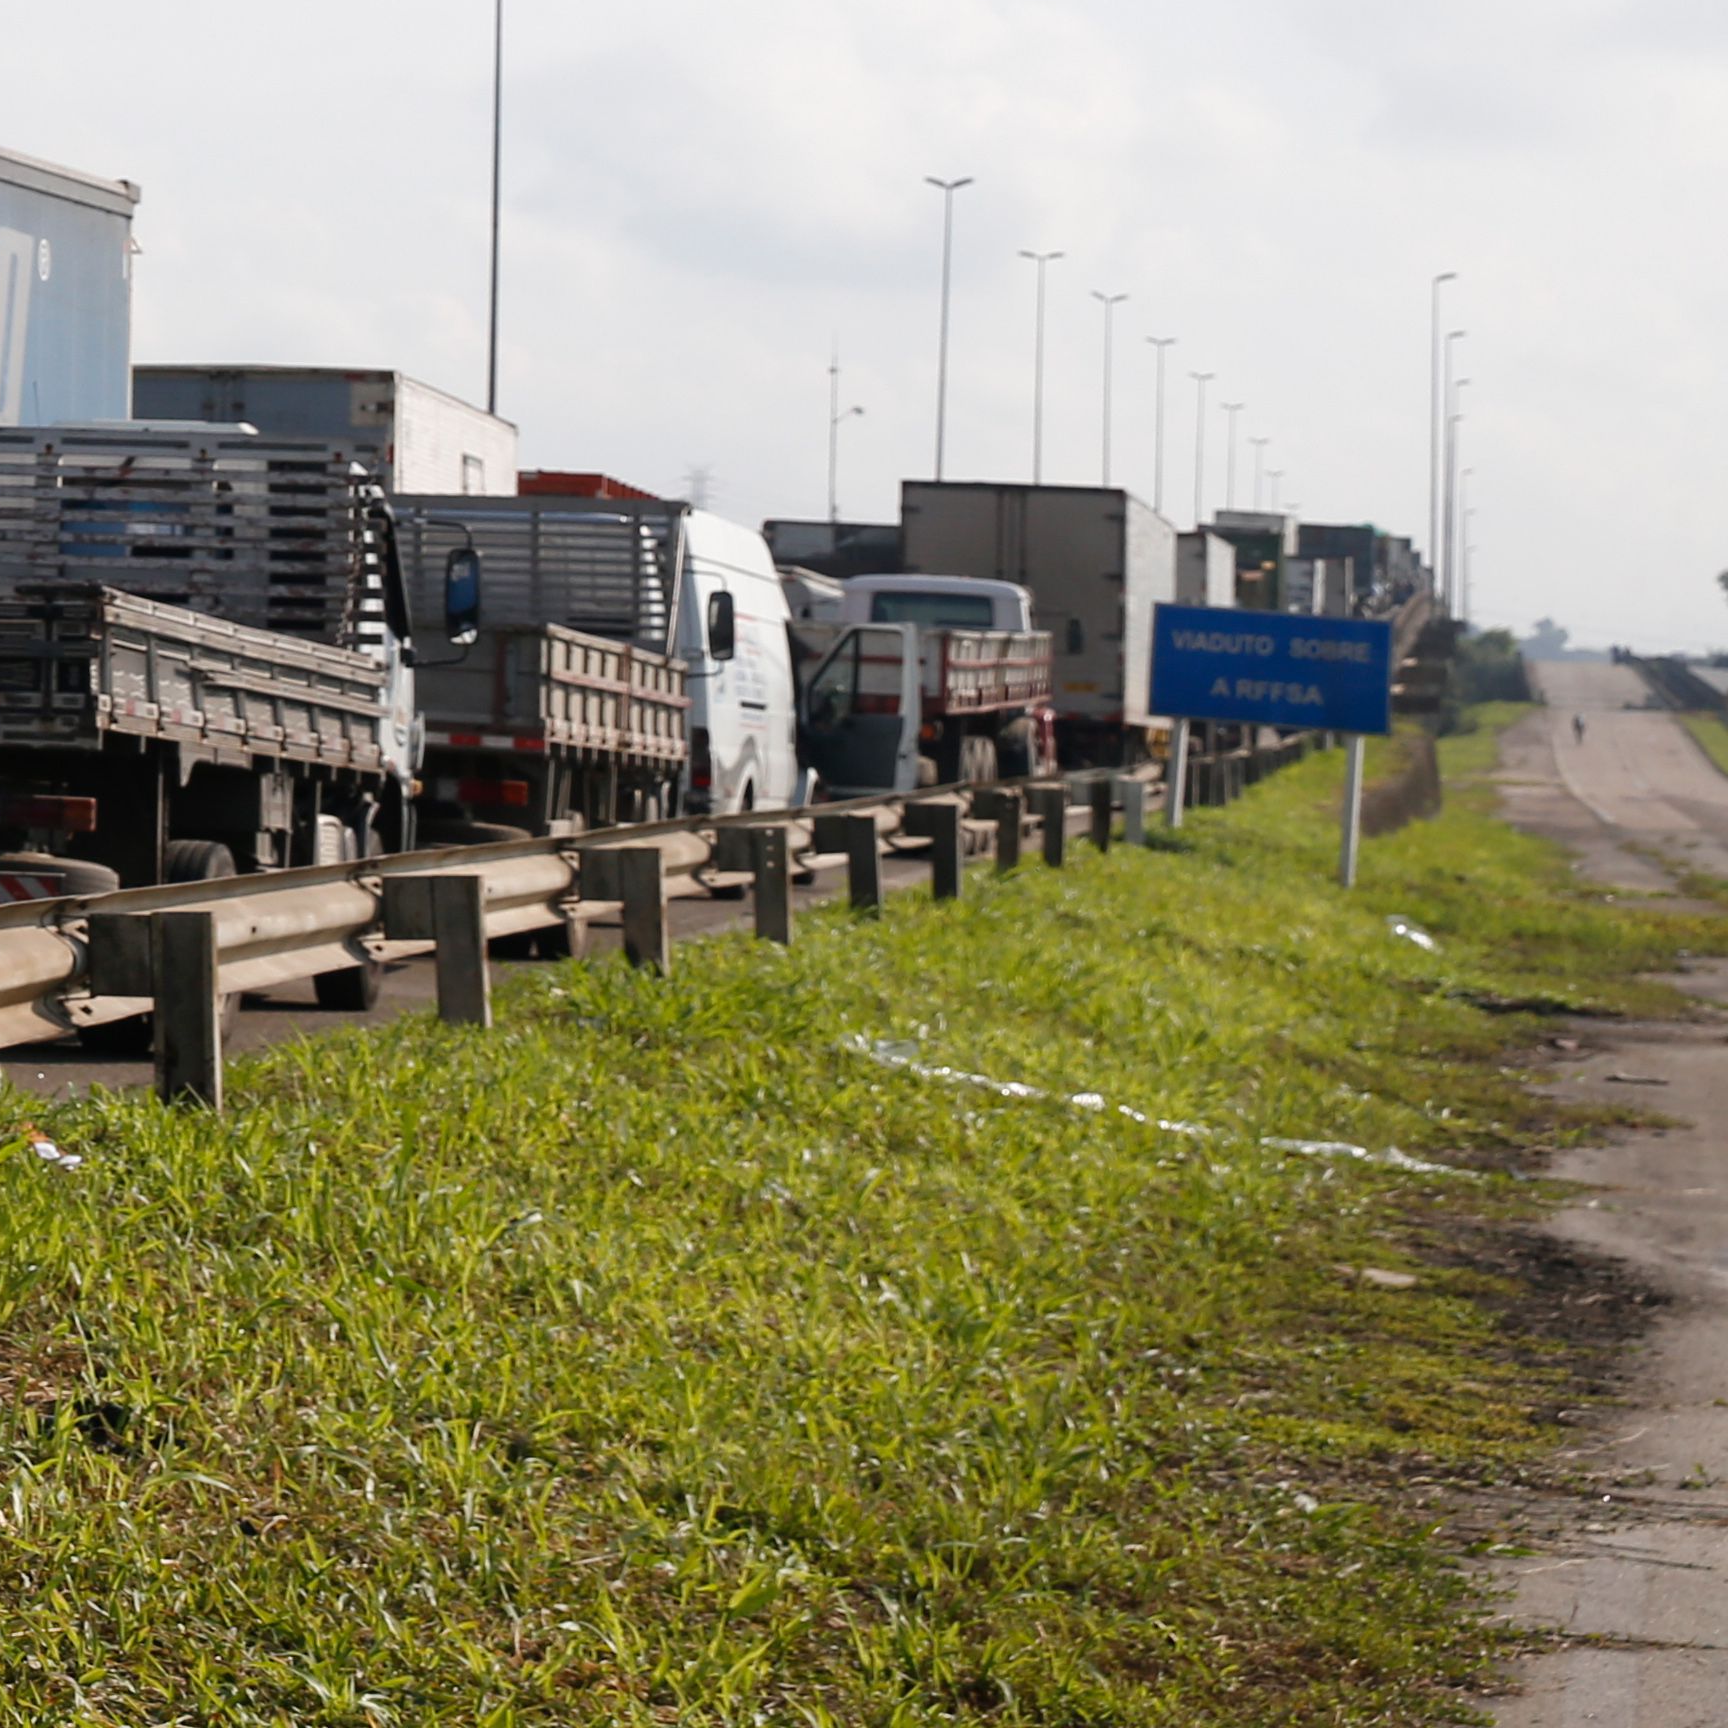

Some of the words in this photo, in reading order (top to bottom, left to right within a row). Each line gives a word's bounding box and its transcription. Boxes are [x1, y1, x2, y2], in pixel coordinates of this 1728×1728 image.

[1170, 630, 1275, 656] VIADUTO
[1288, 637, 1372, 663] SOBRE
[1210, 676, 1230, 698] A
[1235, 678, 1325, 706] RFFSA
